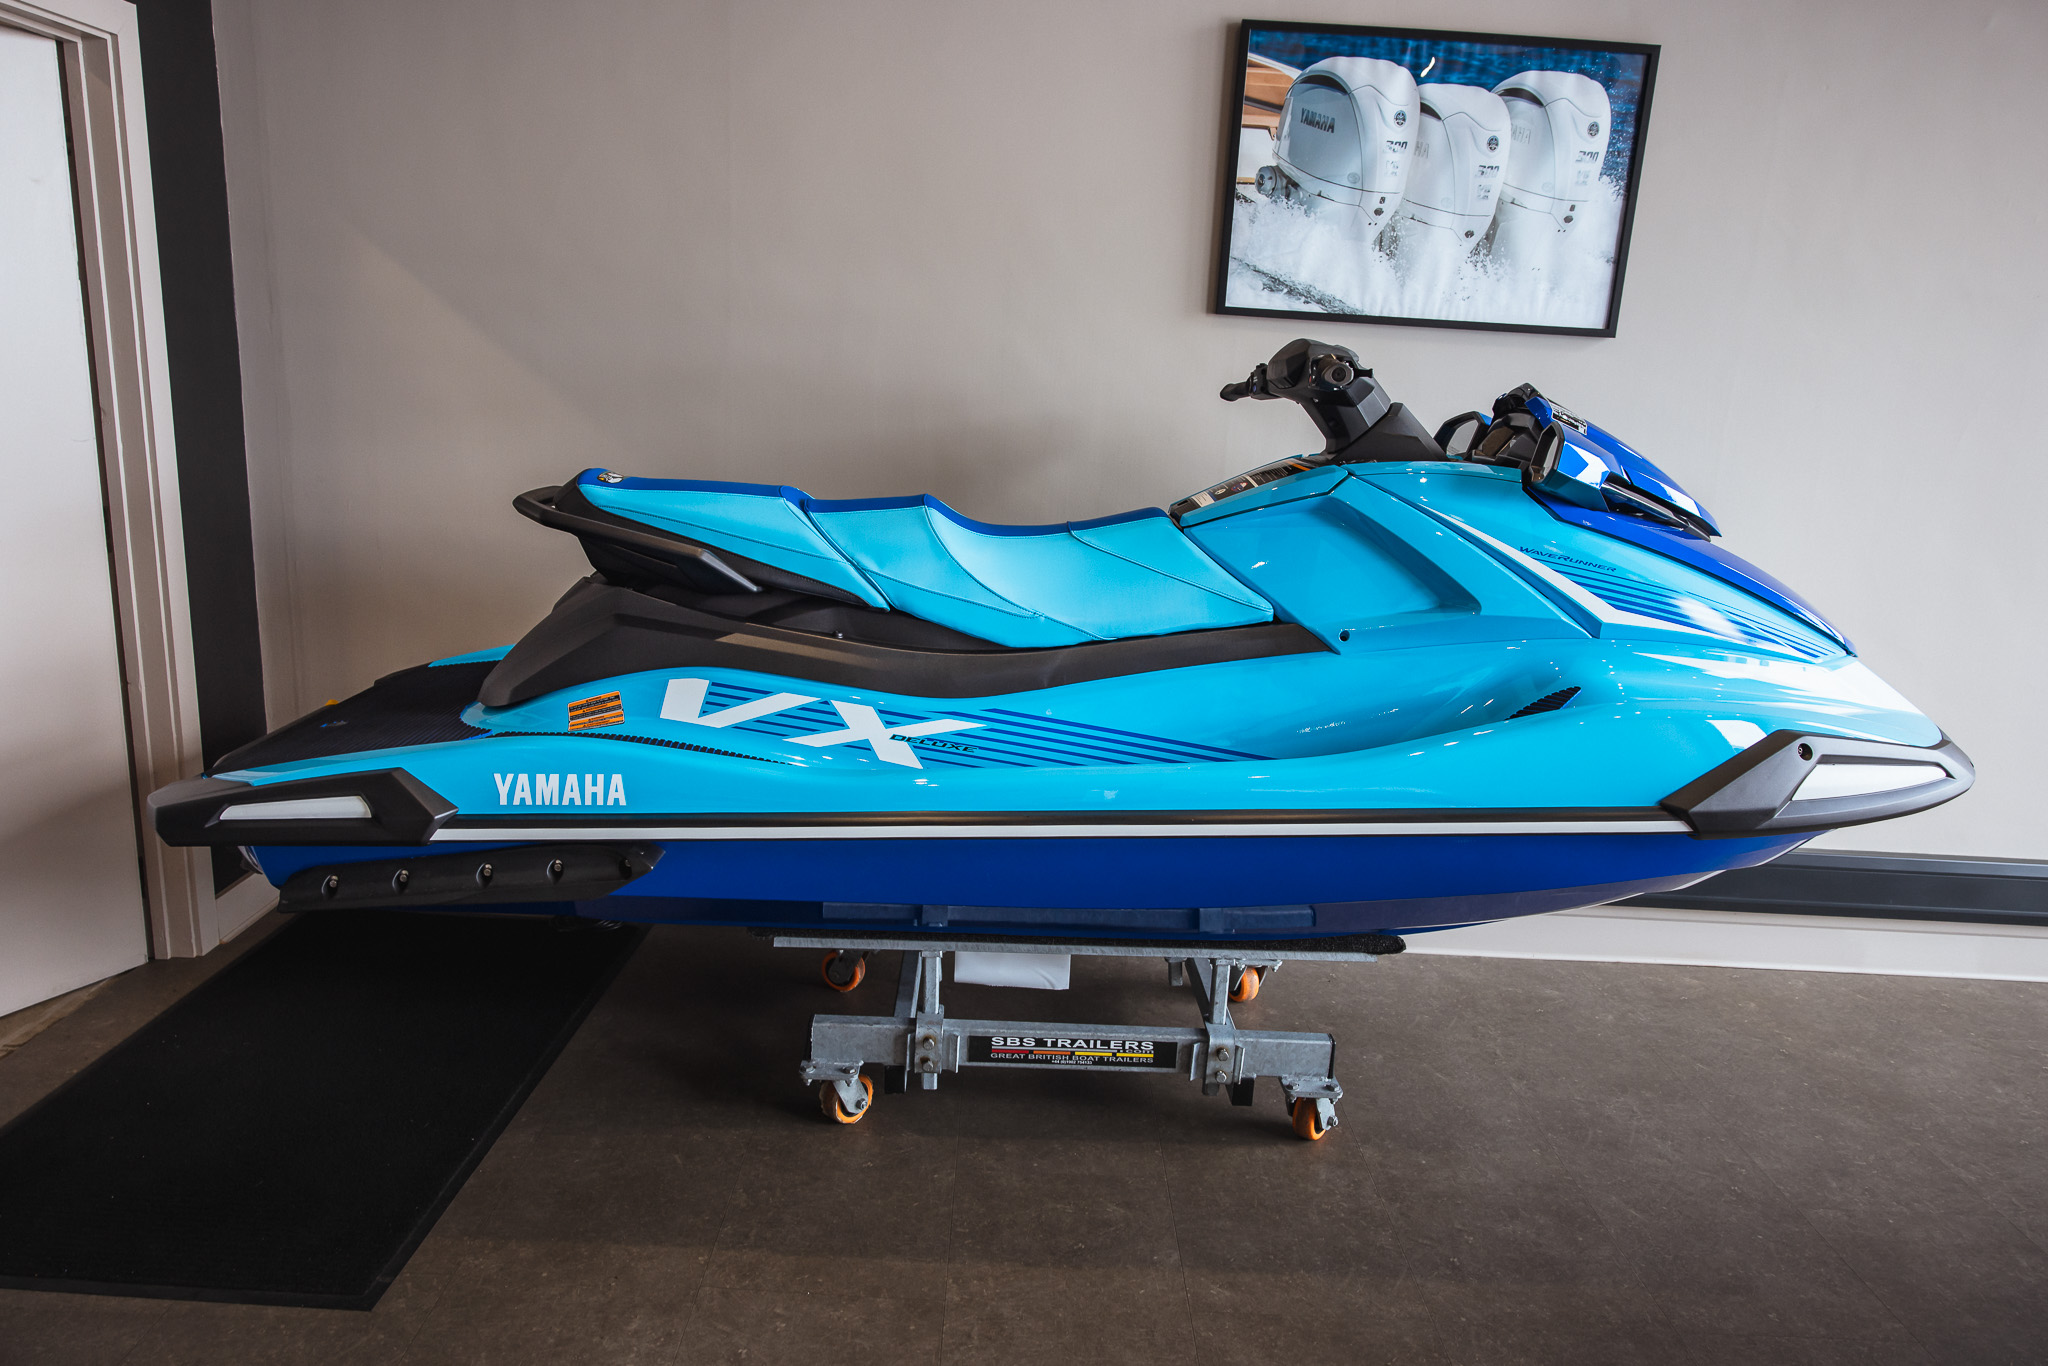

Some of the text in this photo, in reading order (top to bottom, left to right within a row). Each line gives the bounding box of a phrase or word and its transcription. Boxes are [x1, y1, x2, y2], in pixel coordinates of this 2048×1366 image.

[1300, 107, 1336, 134] YAMAHA
[660, 678, 987, 769] VX
[889, 733, 978, 753] DELUXE
[493, 772, 627, 806] YAMAHA
[991, 1036, 1155, 1050] SBS TRAILERS
[1028, 1053, 1070, 1061] BRITISH
